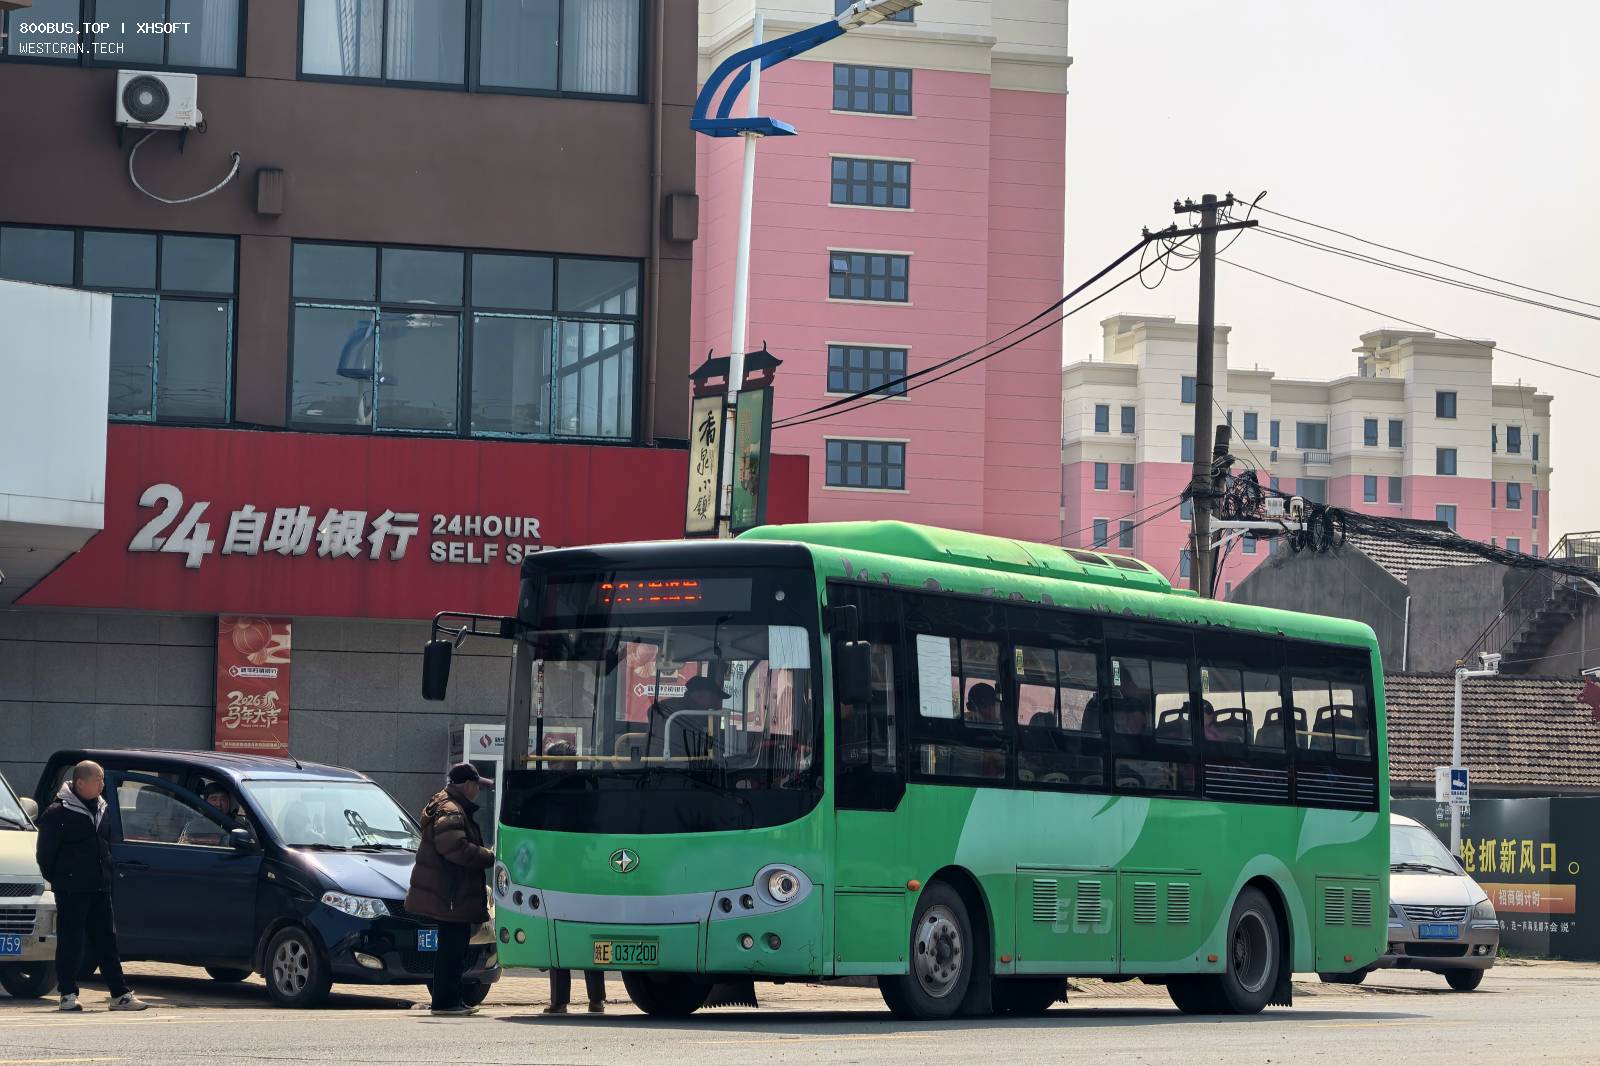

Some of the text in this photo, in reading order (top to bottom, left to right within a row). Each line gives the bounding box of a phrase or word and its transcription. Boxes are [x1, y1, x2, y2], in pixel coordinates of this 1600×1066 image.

[431, 514, 541, 540] 24HOUR
[430, 540, 498, 564] SELF
[227, 690, 260, 707] 2026
[222, 706, 281, 729] 马年大吉
